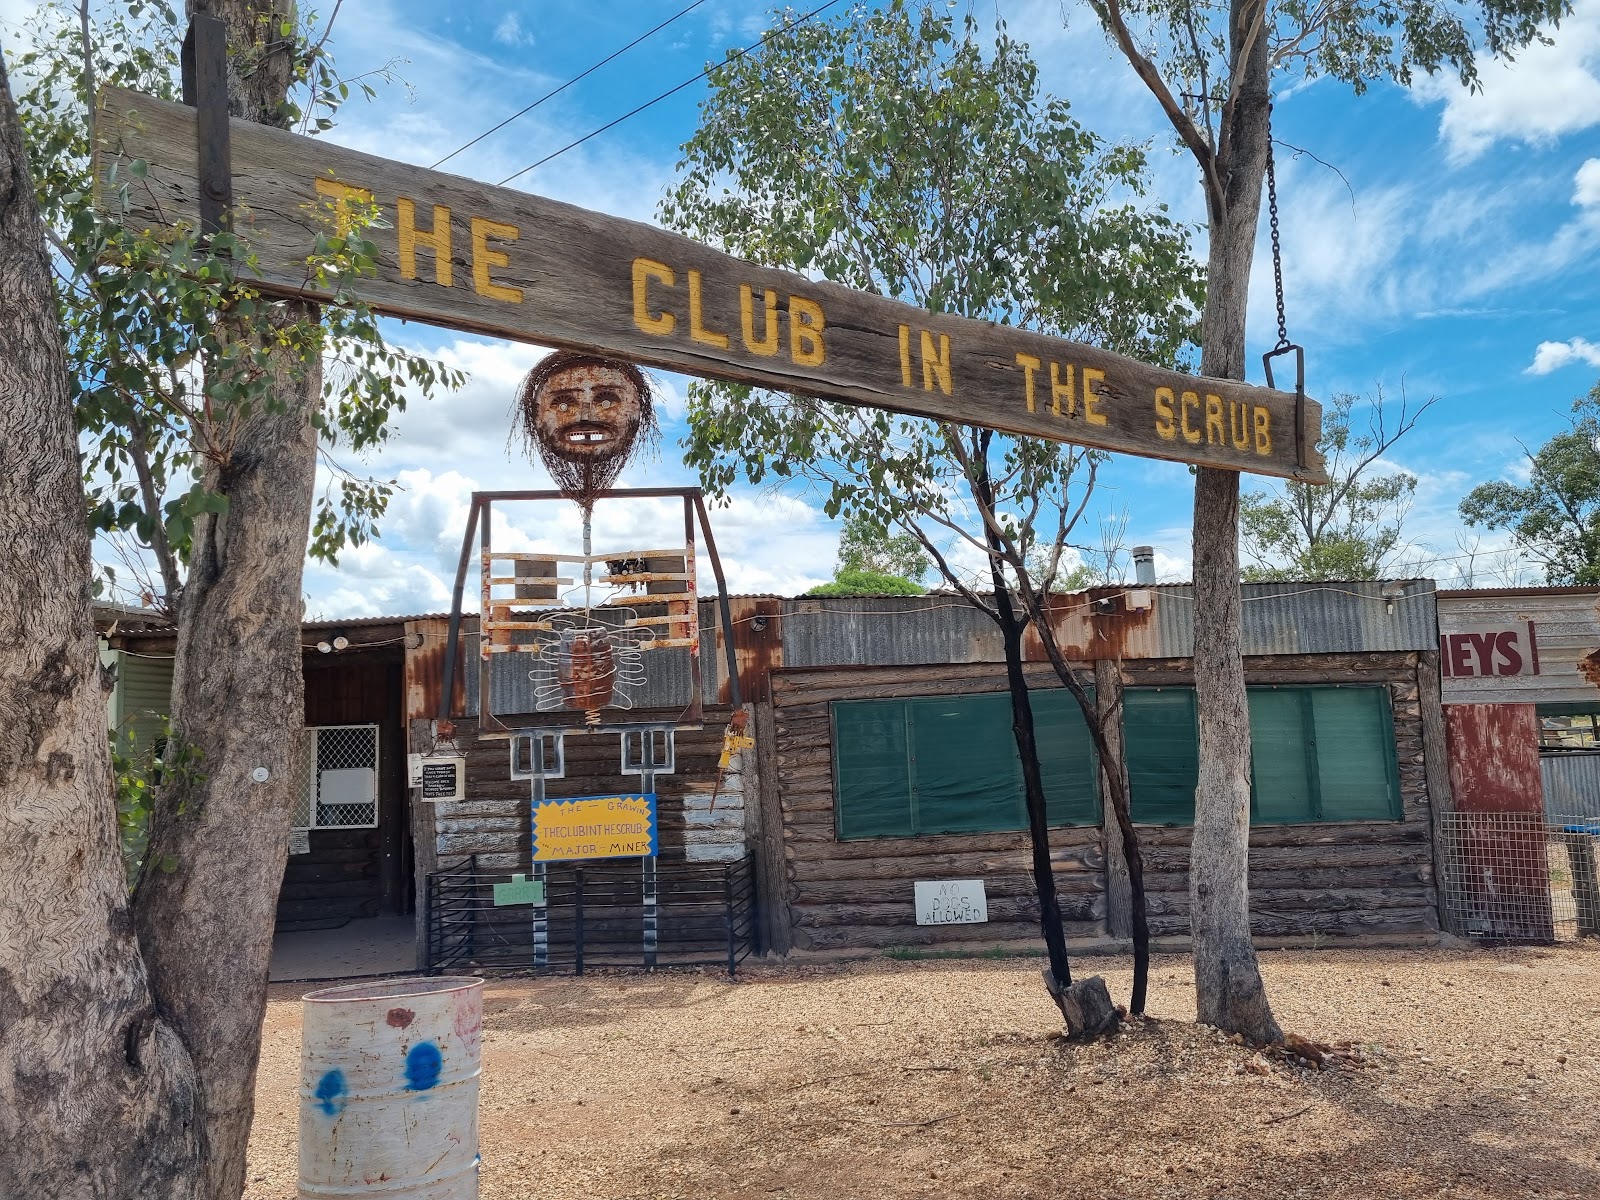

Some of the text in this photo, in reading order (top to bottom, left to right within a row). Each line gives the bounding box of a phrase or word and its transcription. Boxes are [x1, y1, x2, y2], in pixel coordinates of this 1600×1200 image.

[315, 176, 1273, 456] THE CLUB IN THE SCRUB
[560, 805, 582, 816] THE
[551, 844, 598, 856] MAJOR
[939, 883, 960, 896] NO
[932, 896, 971, 911] DOGS
[924, 908, 981, 924] ALLOWED
